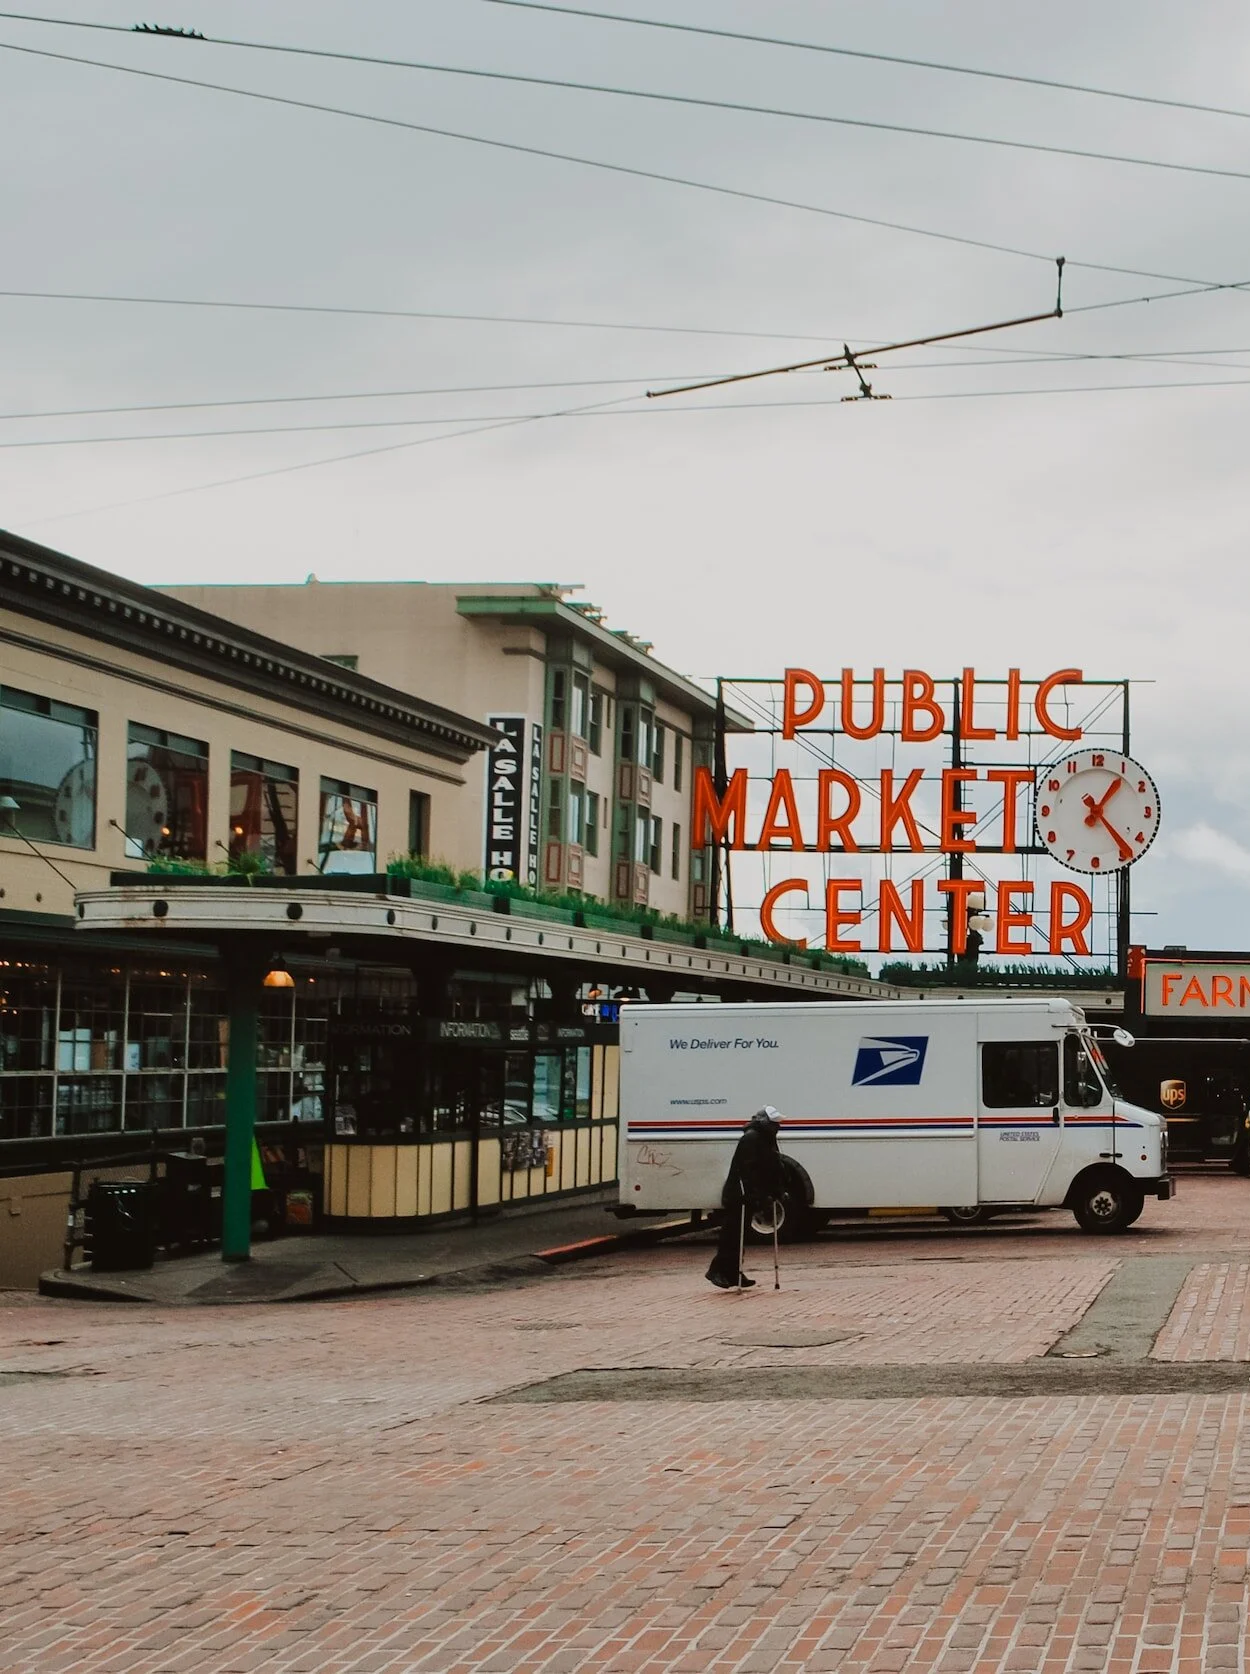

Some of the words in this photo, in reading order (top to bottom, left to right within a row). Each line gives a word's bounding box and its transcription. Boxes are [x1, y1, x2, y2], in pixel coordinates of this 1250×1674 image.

[783, 669, 1083, 743] PUBLIC
[1067, 761, 1077, 773] 11
[1092, 755, 1105, 767] 12
[1121, 762, 1126, 773] 1
[1048, 779, 1060, 791] 10
[1138, 781, 1145, 792] 2
[492, 758, 518, 840] SALLE
[529, 766, 540, 846] SALLE
[692, 767, 1036, 854] MARKET
[1042, 805, 1050, 816] 9
[1144, 806, 1152, 818] 3
[1048, 831, 1056, 843] 8
[1135, 832, 1144, 843] 4
[1067, 850, 1075, 861] 7
[1091, 857, 1100, 868] 6
[761, 879, 1093, 956] CENTER
[669, 1039, 688, 1050] We
[690, 1038, 732, 1049] Deliver
[734, 1038, 754, 1049] For
[756, 1038, 780, 1049] You.
[669, 1097, 728, 1106] www.usps.com
[1163, 1087, 1185, 1106] ups
